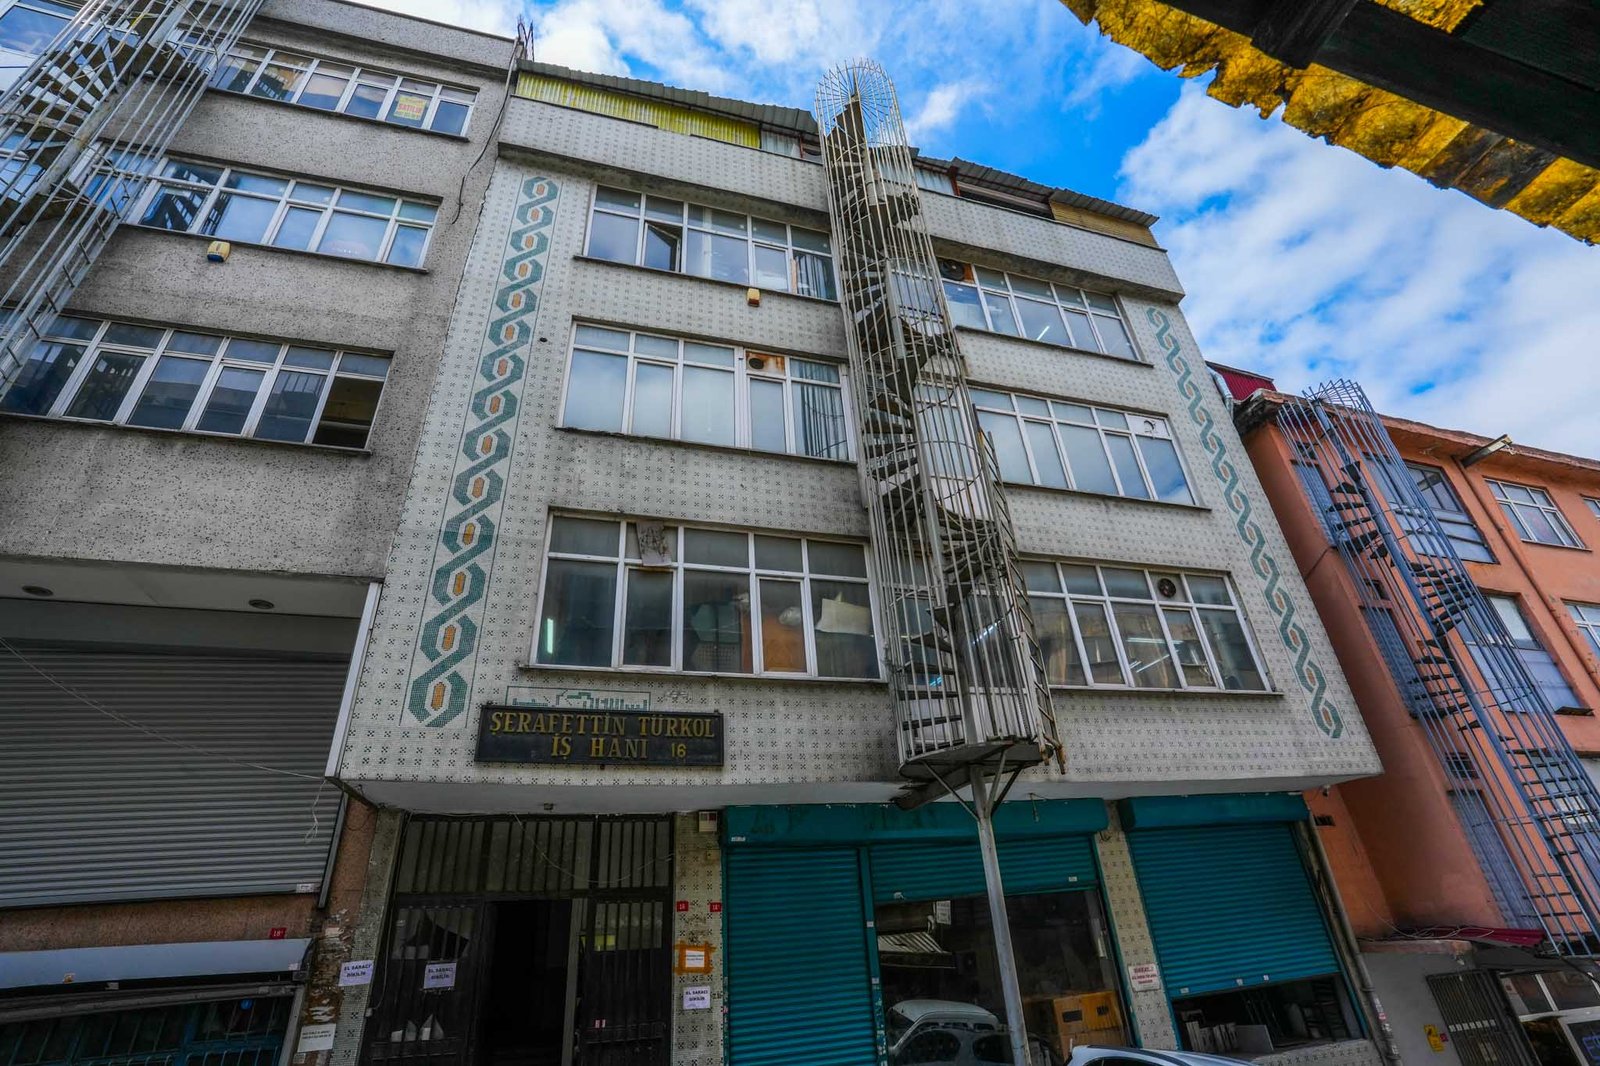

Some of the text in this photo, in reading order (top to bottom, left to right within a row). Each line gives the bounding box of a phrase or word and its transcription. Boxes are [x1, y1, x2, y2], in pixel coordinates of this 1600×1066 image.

[489, 711, 715, 738] ŞERAFETTİN TÜRKOL
[551, 732, 687, 760] İŞ HANI 16
